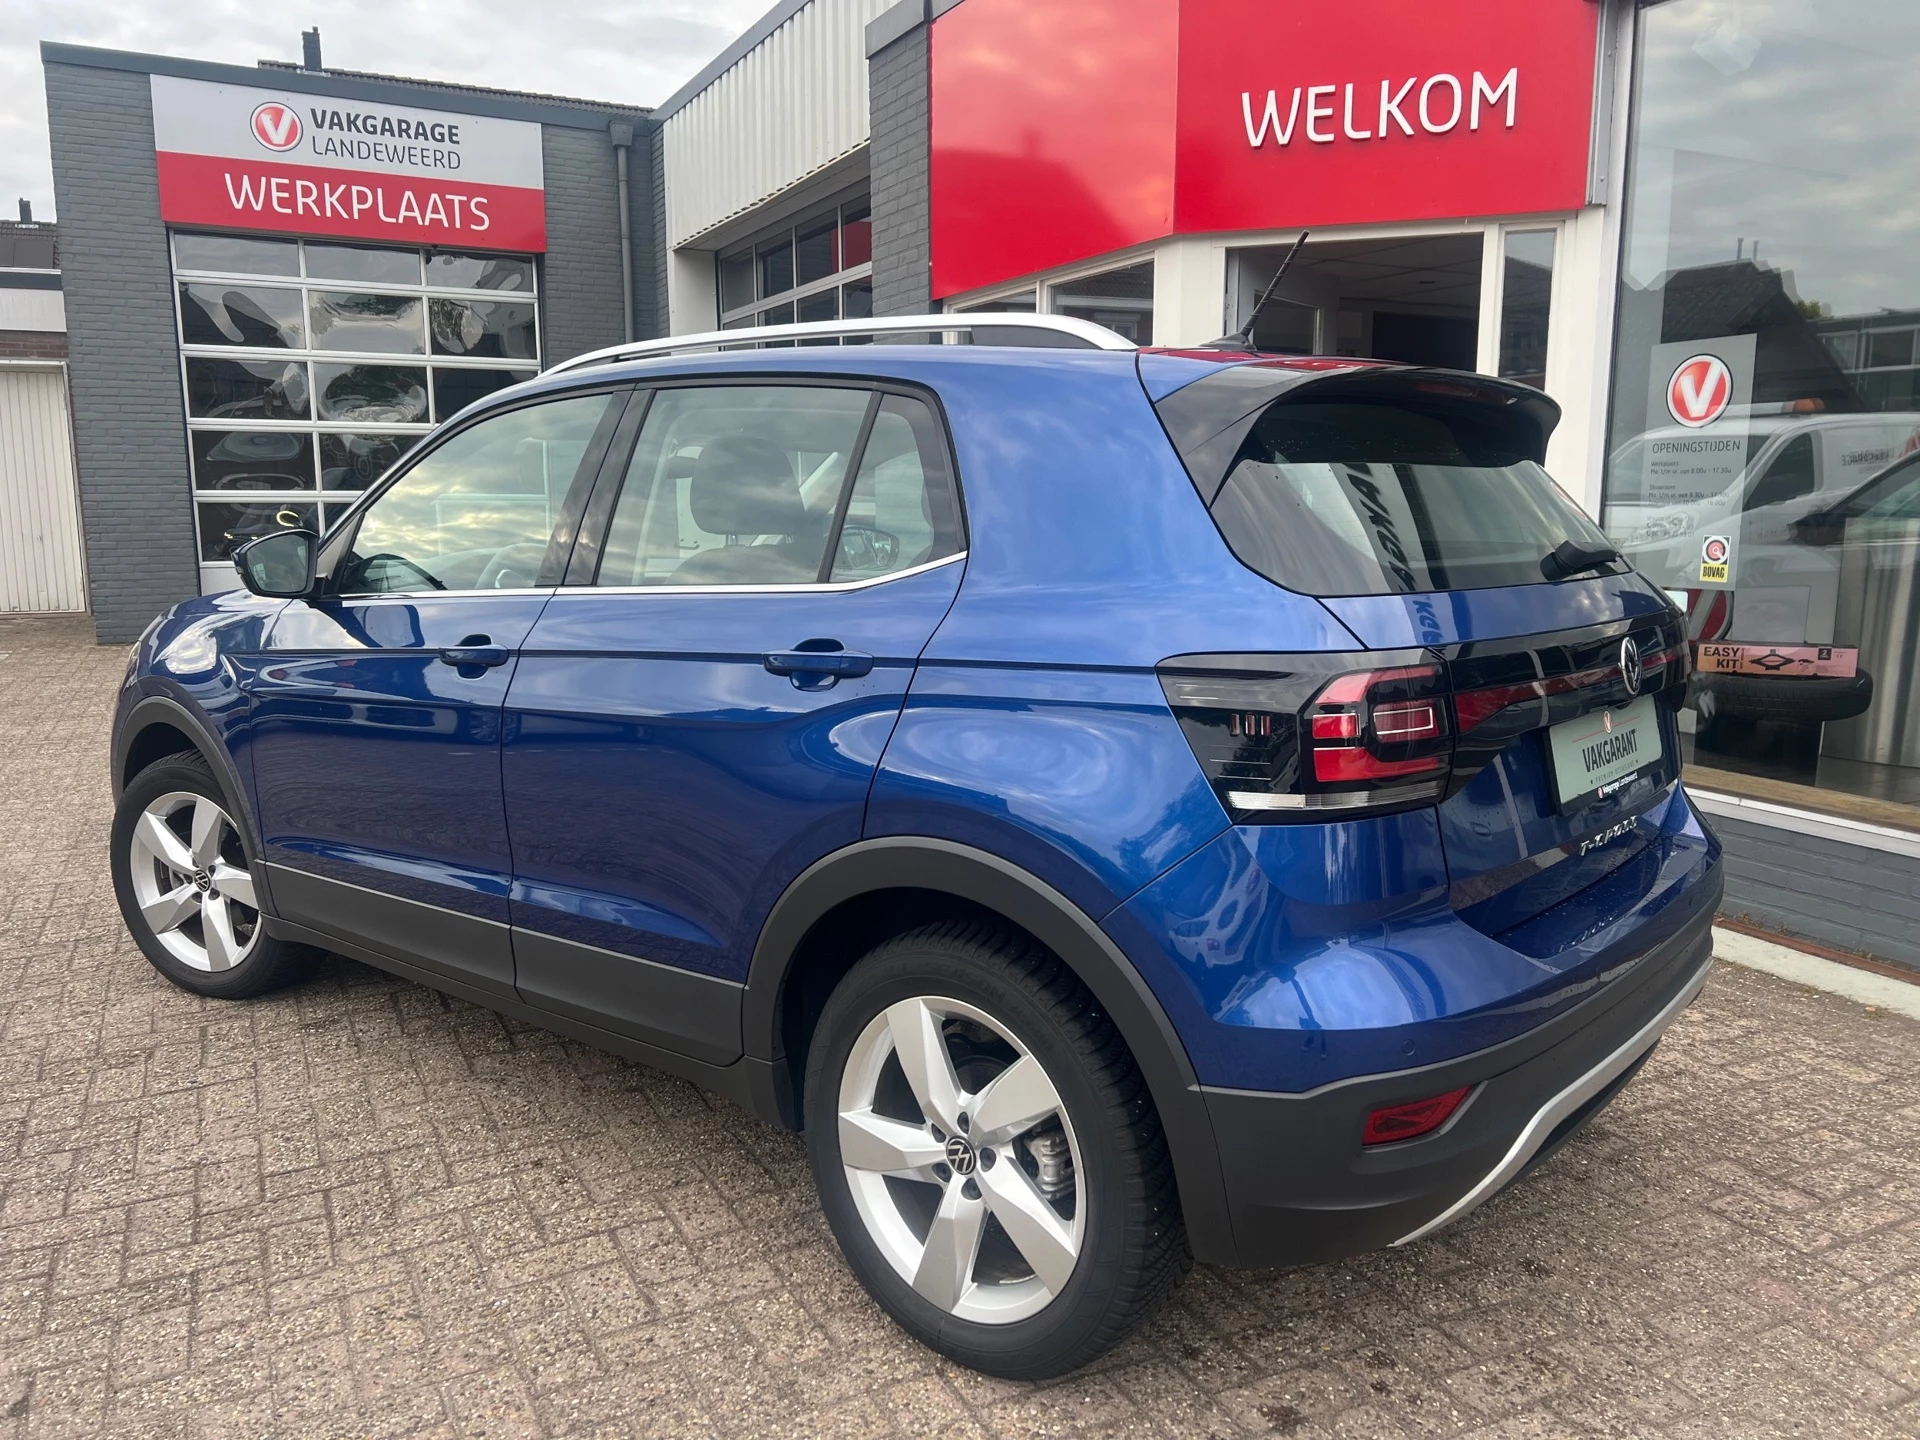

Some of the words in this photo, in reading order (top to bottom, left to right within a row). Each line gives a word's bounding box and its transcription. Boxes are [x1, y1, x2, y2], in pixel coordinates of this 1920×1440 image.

[1241, 67, 1518, 147] WELKOM
[310, 108, 460, 145] VAKGARAGE
[312, 135, 461, 169] LANDEWEERD
[224, 172, 490, 231] WERKPLAATS
[1652, 440, 1741, 454] OPENINGSTIJDEN
[1712, 466, 1732, 474] 17.30u
[1702, 566, 1725, 578] BOVAG
[1703, 646, 1740, 657] EASY
[1716, 658, 1740, 669] KIT
[1582, 728, 1638, 773] VAKGARANT
